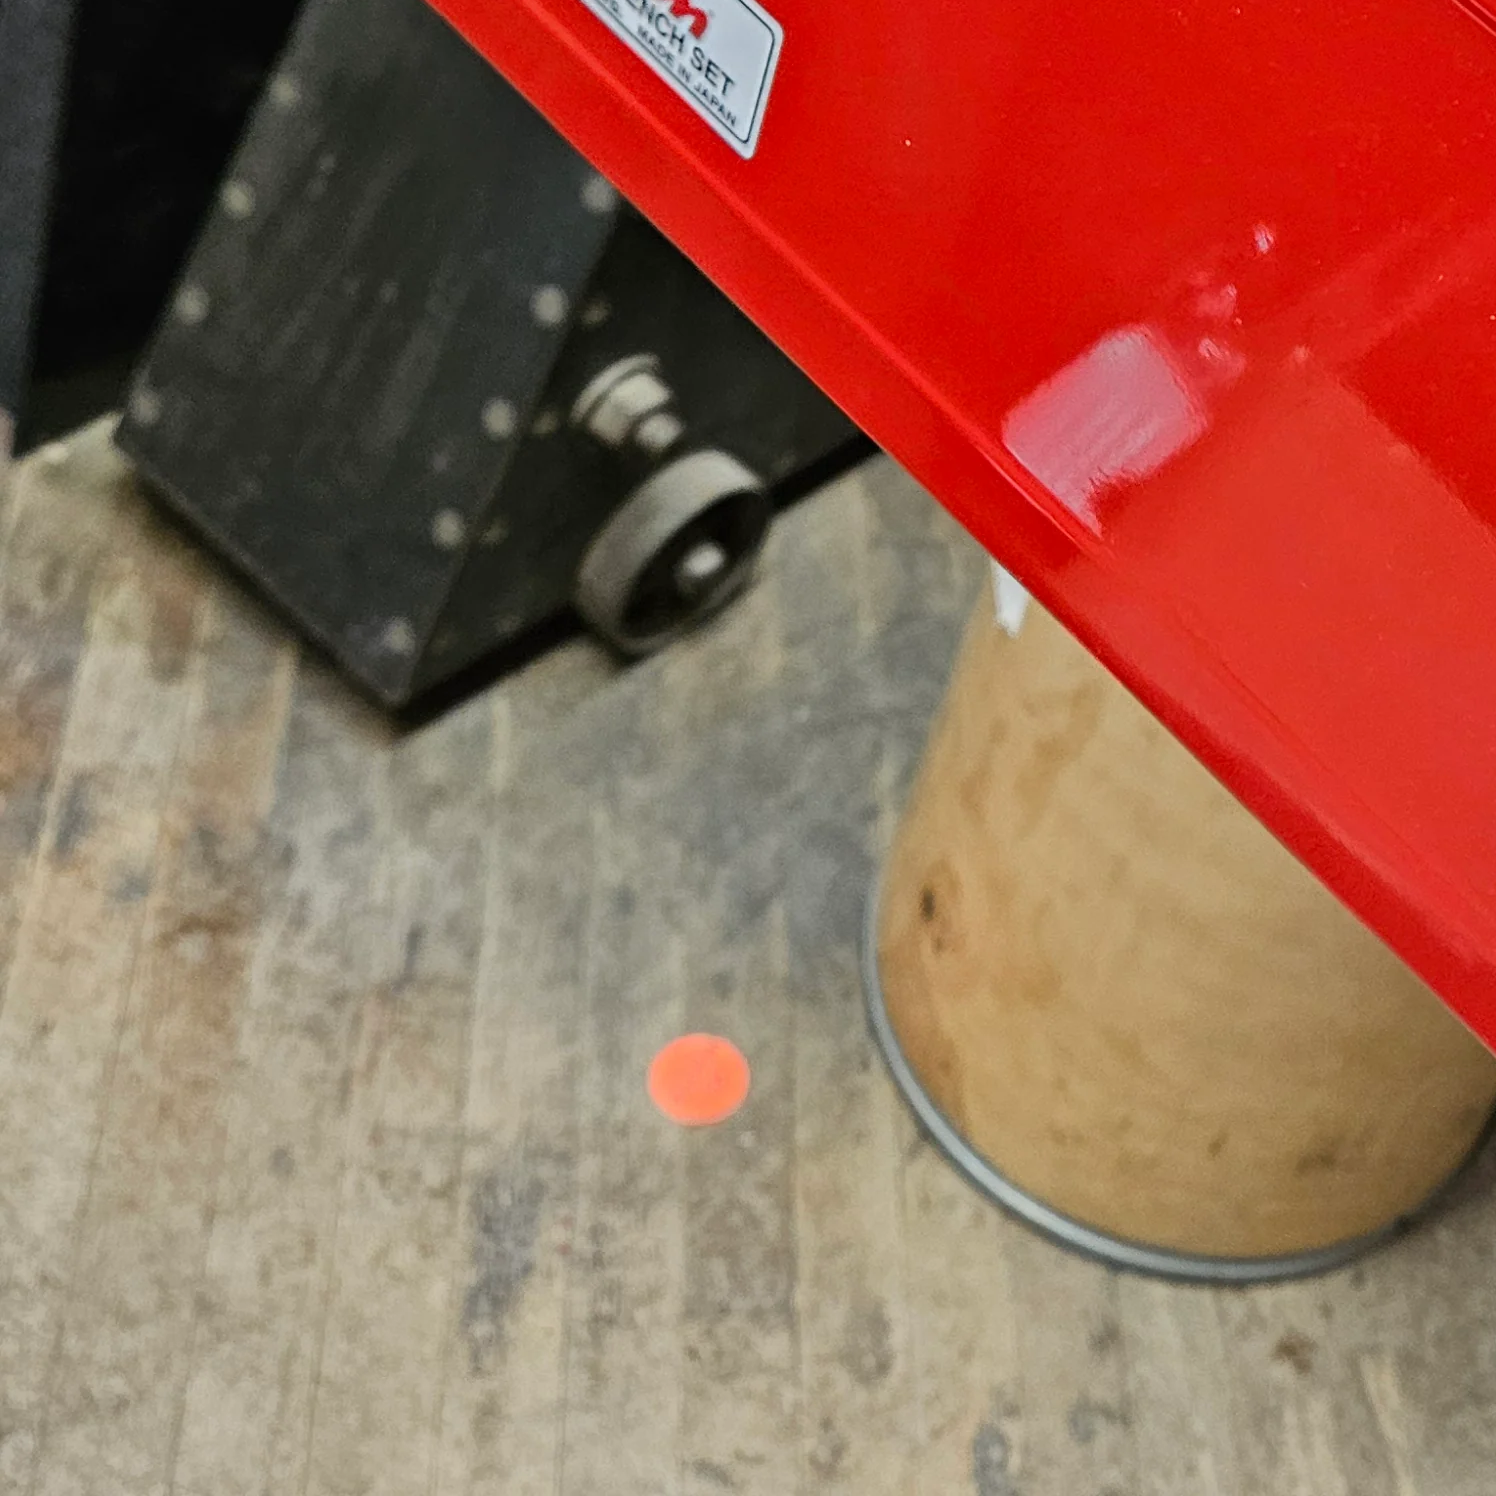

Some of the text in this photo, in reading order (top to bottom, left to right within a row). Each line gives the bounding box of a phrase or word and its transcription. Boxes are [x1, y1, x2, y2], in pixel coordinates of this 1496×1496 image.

[638, 25, 674, 68] MADE
[677, 64, 692, 84] IN
[693, 82, 738, 126] JAPAN
[690, 45, 736, 96] SET
